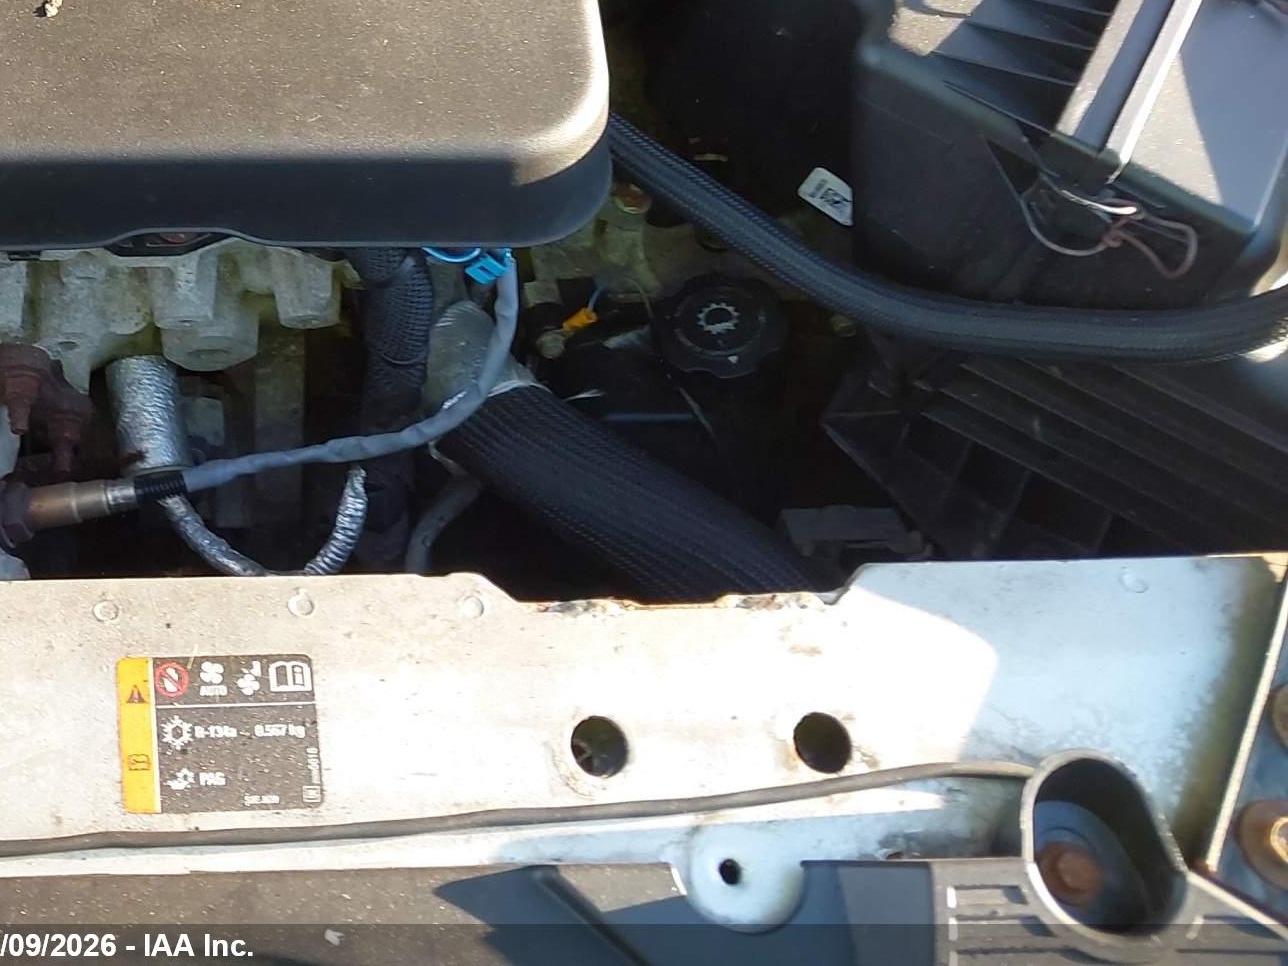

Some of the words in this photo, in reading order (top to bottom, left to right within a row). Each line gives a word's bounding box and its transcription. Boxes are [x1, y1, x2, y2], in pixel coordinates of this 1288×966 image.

[194, 724, 238, 738] R-134a
[288, 723, 306, 738] kg
[198, 772, 227, 786] PAG
